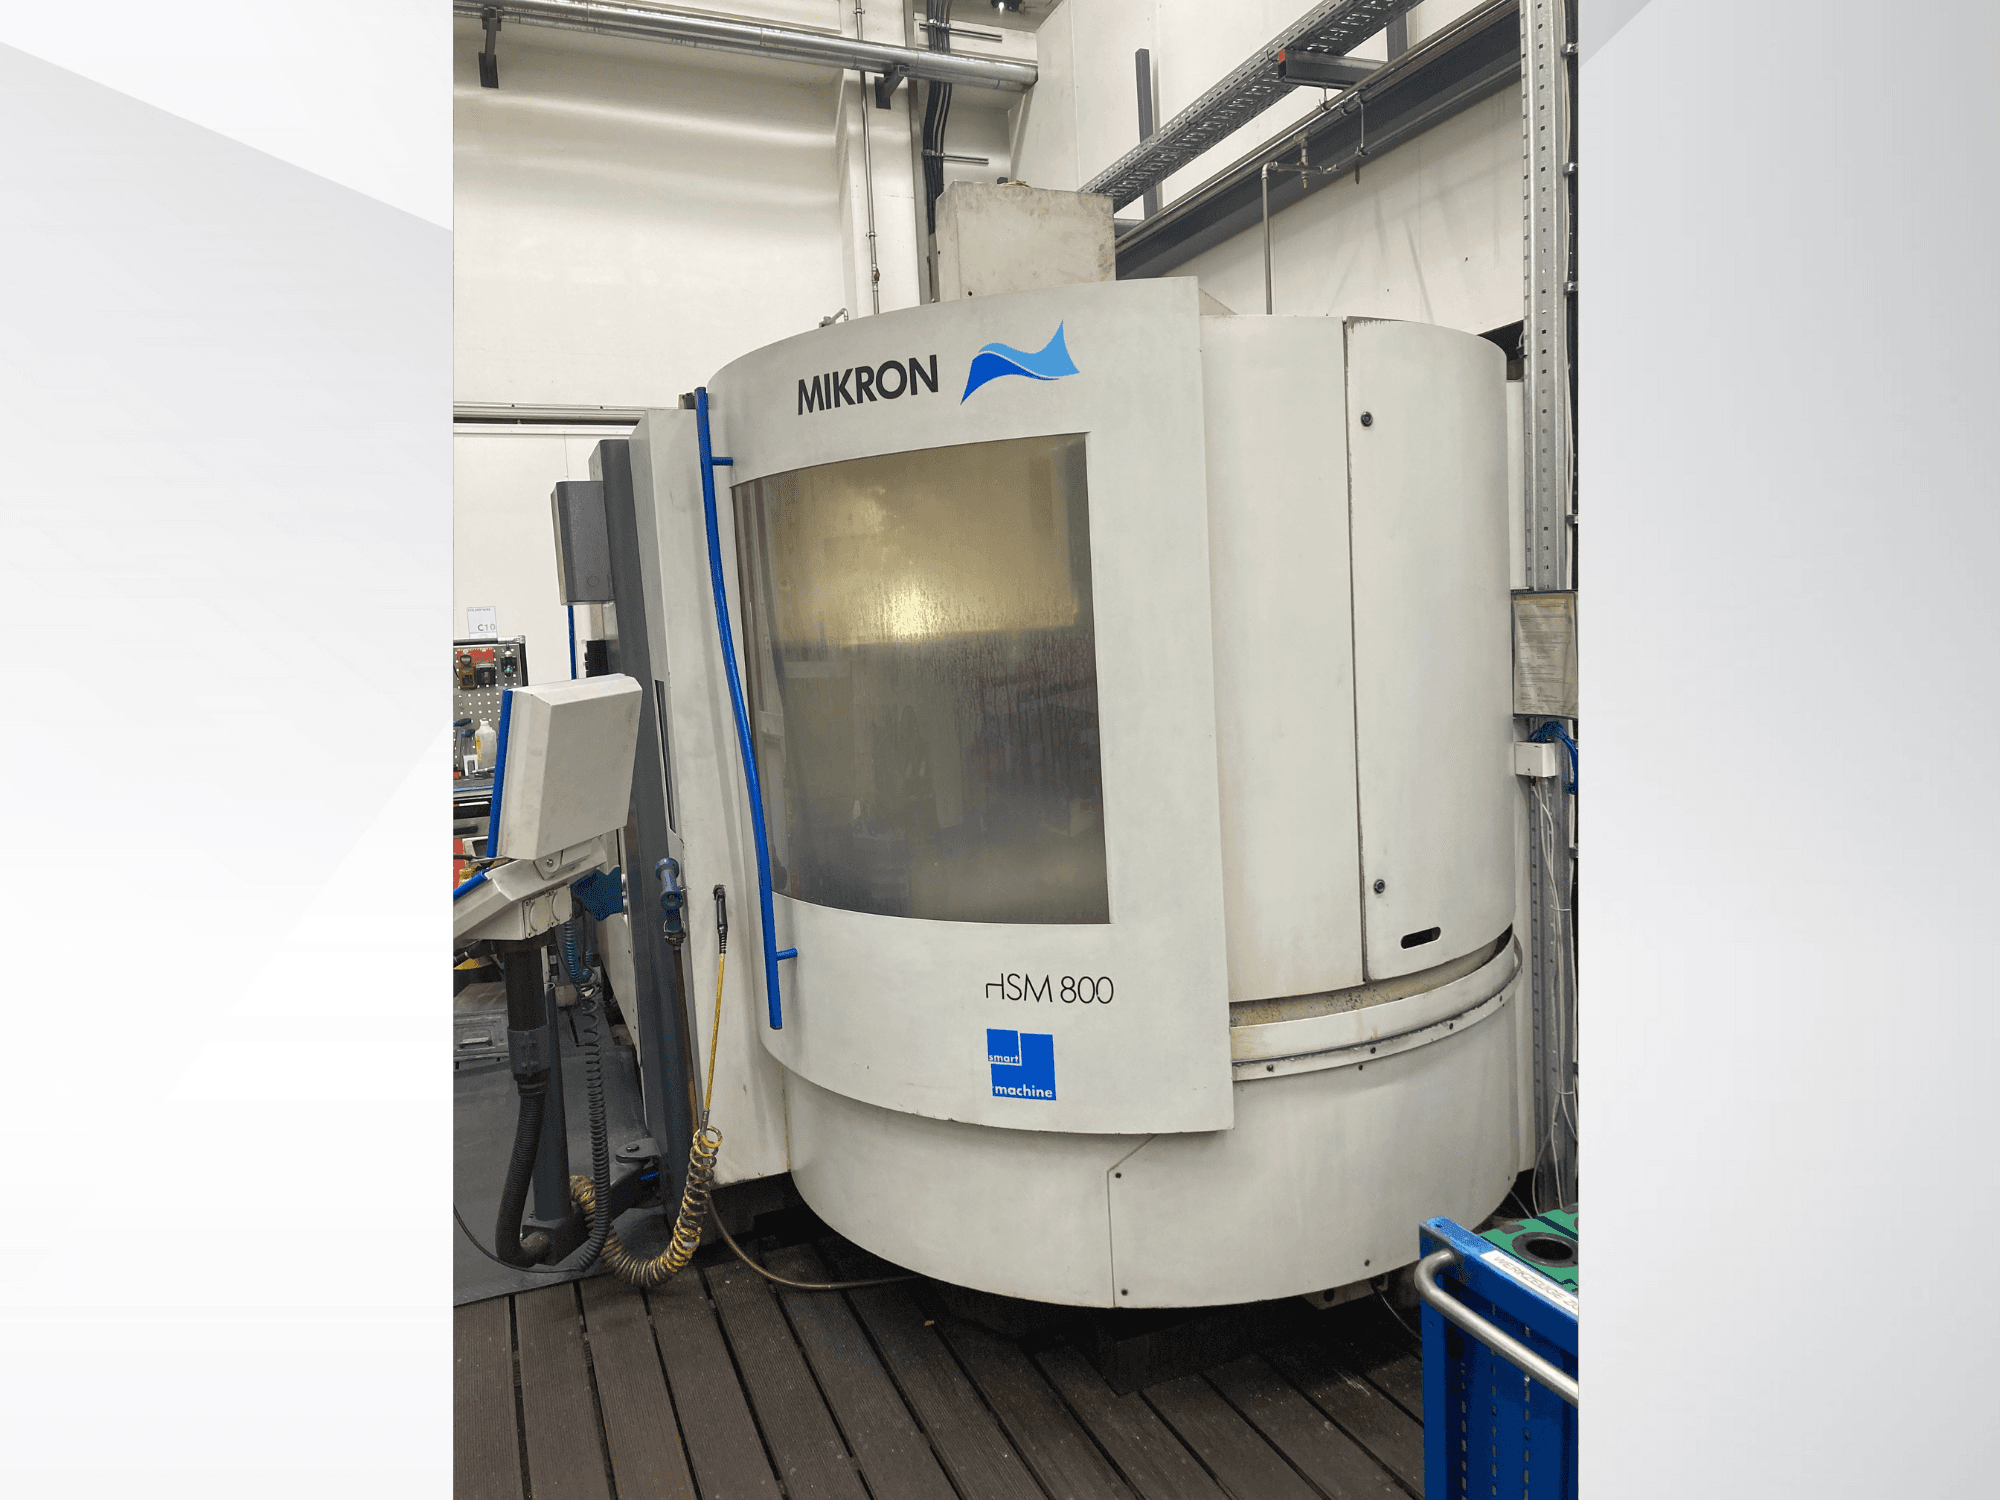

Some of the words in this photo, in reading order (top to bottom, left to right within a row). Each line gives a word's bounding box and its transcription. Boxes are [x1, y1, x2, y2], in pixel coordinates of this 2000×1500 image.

[798, 354, 938, 415] MIKRON
[477, 623, 496, 632] C10
[985, 972, 1053, 1003] HSM
[1060, 975, 1114, 1005] 800
[988, 1054, 1019, 1063] smart
[994, 1083, 1053, 1099] machine
[1493, 1256, 1567, 1300] WERKZEUGE
